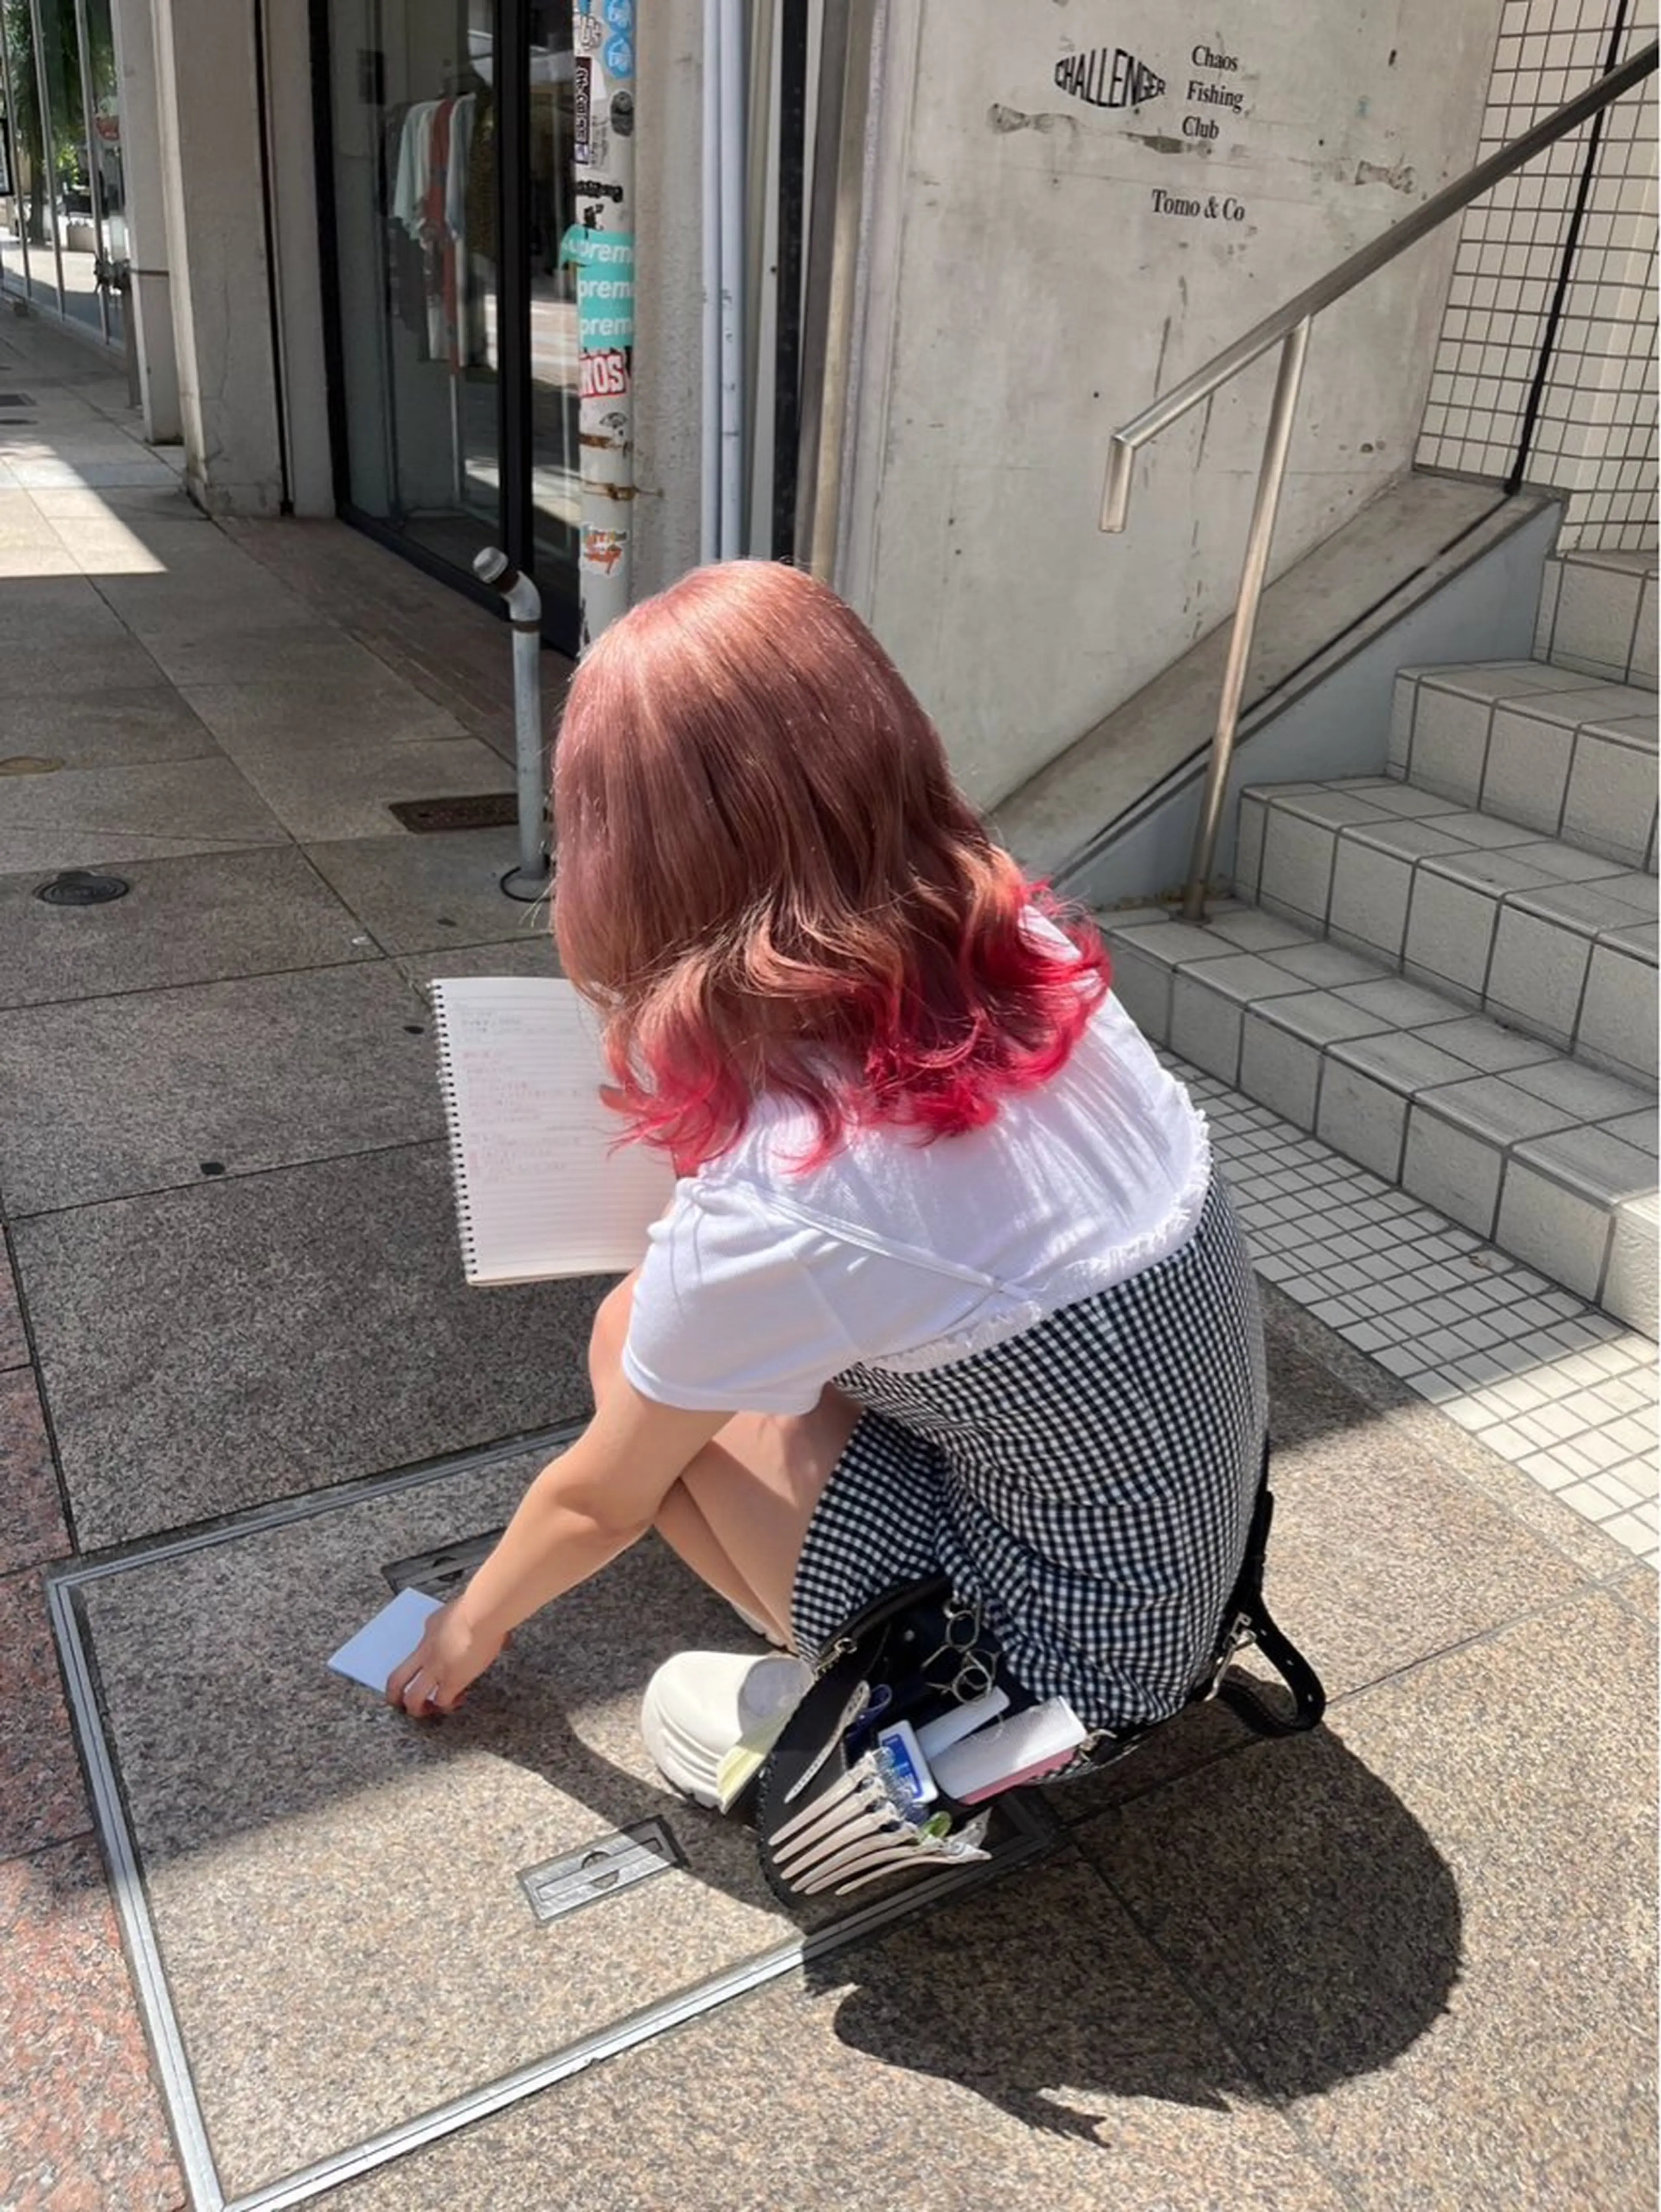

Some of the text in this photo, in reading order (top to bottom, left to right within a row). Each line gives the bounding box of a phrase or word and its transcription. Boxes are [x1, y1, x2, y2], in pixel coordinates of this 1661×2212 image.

[1192, 45, 1238, 72] Chaos
[1055, 48, 1166, 107] CHALLENGER
[1187, 80, 1244, 114] Fishing
[1182, 115, 1219, 139] Club
[1151, 188, 1245, 221] Tomo & Co
